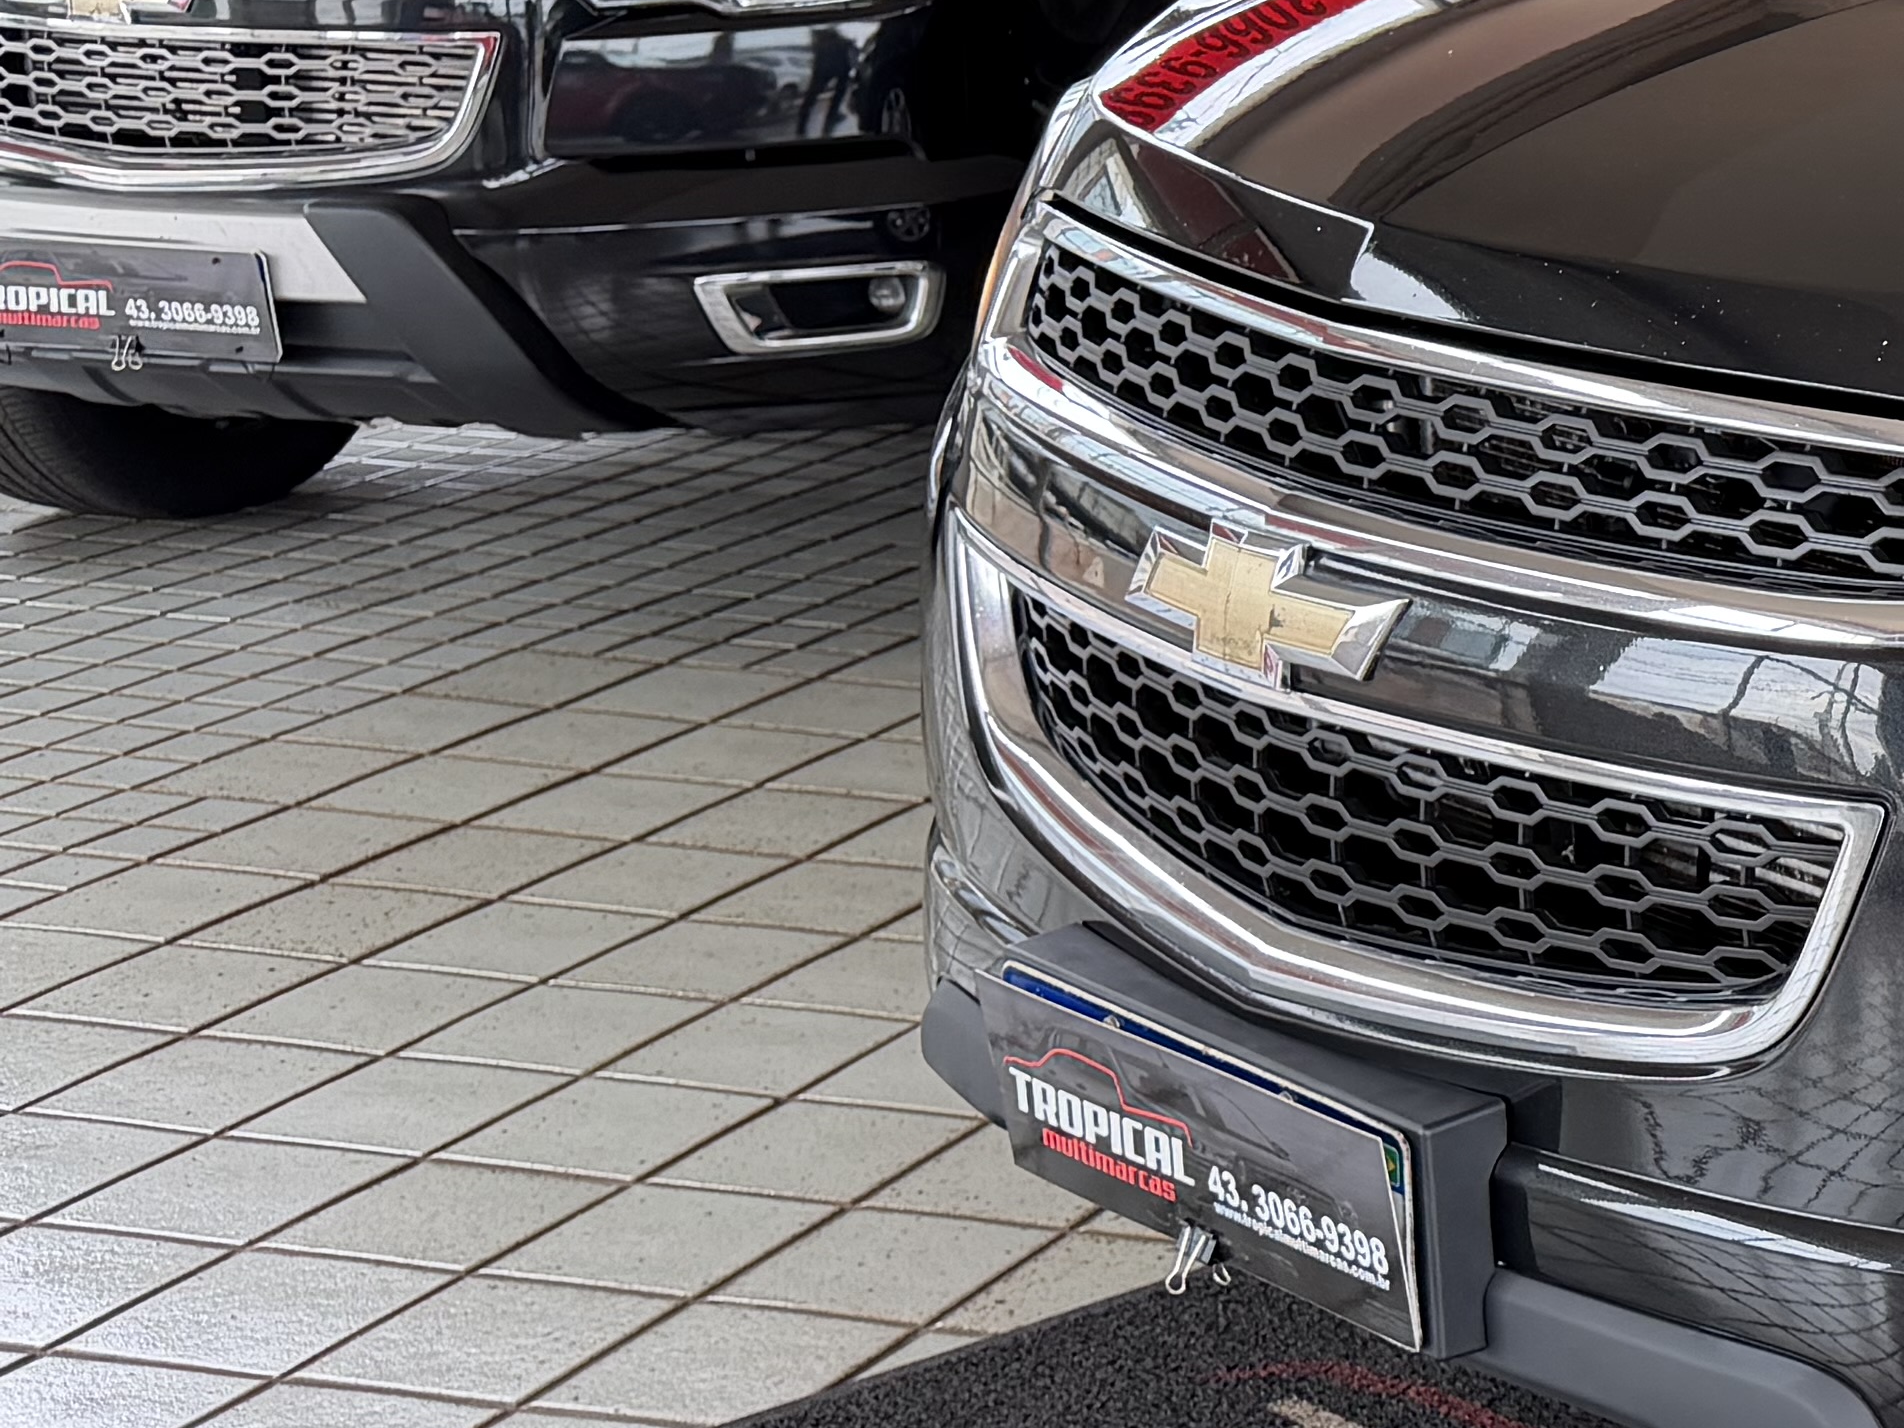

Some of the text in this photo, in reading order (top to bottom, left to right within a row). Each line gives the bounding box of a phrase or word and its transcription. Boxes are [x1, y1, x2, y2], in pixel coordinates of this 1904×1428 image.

[0, 284, 116, 317] OPICAL
[1008, 1065, 1195, 1187] TROPICAL
[1041, 1126, 1177, 1202] multimarcas
[1251, 1183, 1390, 1276] 3066-9398
